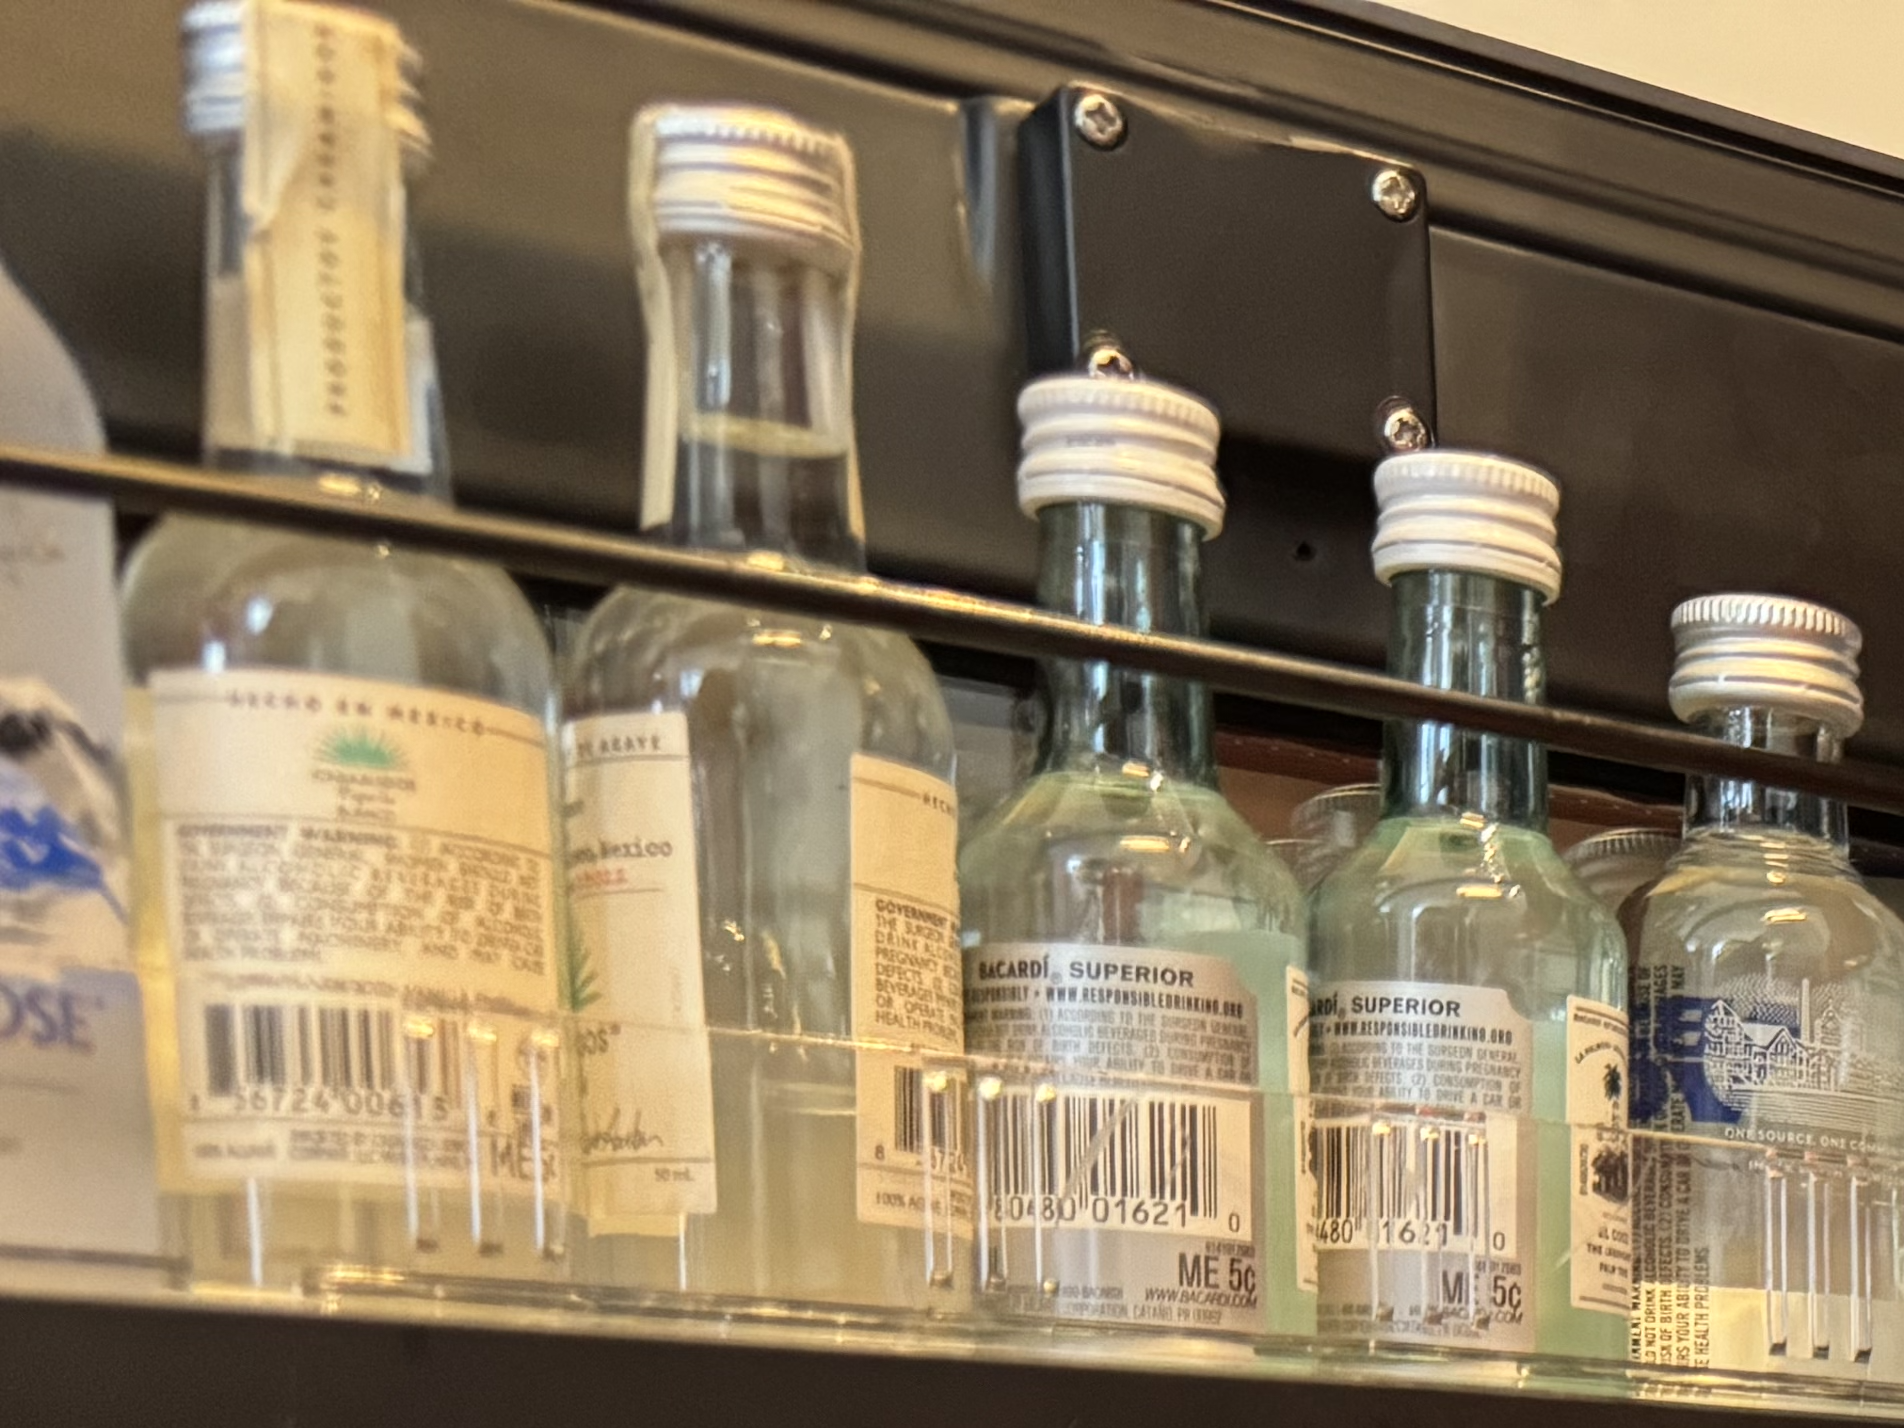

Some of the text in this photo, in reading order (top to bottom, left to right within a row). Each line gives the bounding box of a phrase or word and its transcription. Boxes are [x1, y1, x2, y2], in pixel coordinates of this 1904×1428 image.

[1070, 961, 1194, 987] SUPERIOR
[1351, 995, 1461, 1017] SUPERIOR
[1092, 1198, 1187, 1228] 01621
[1178, 1252, 1256, 1294] ME 5¢
